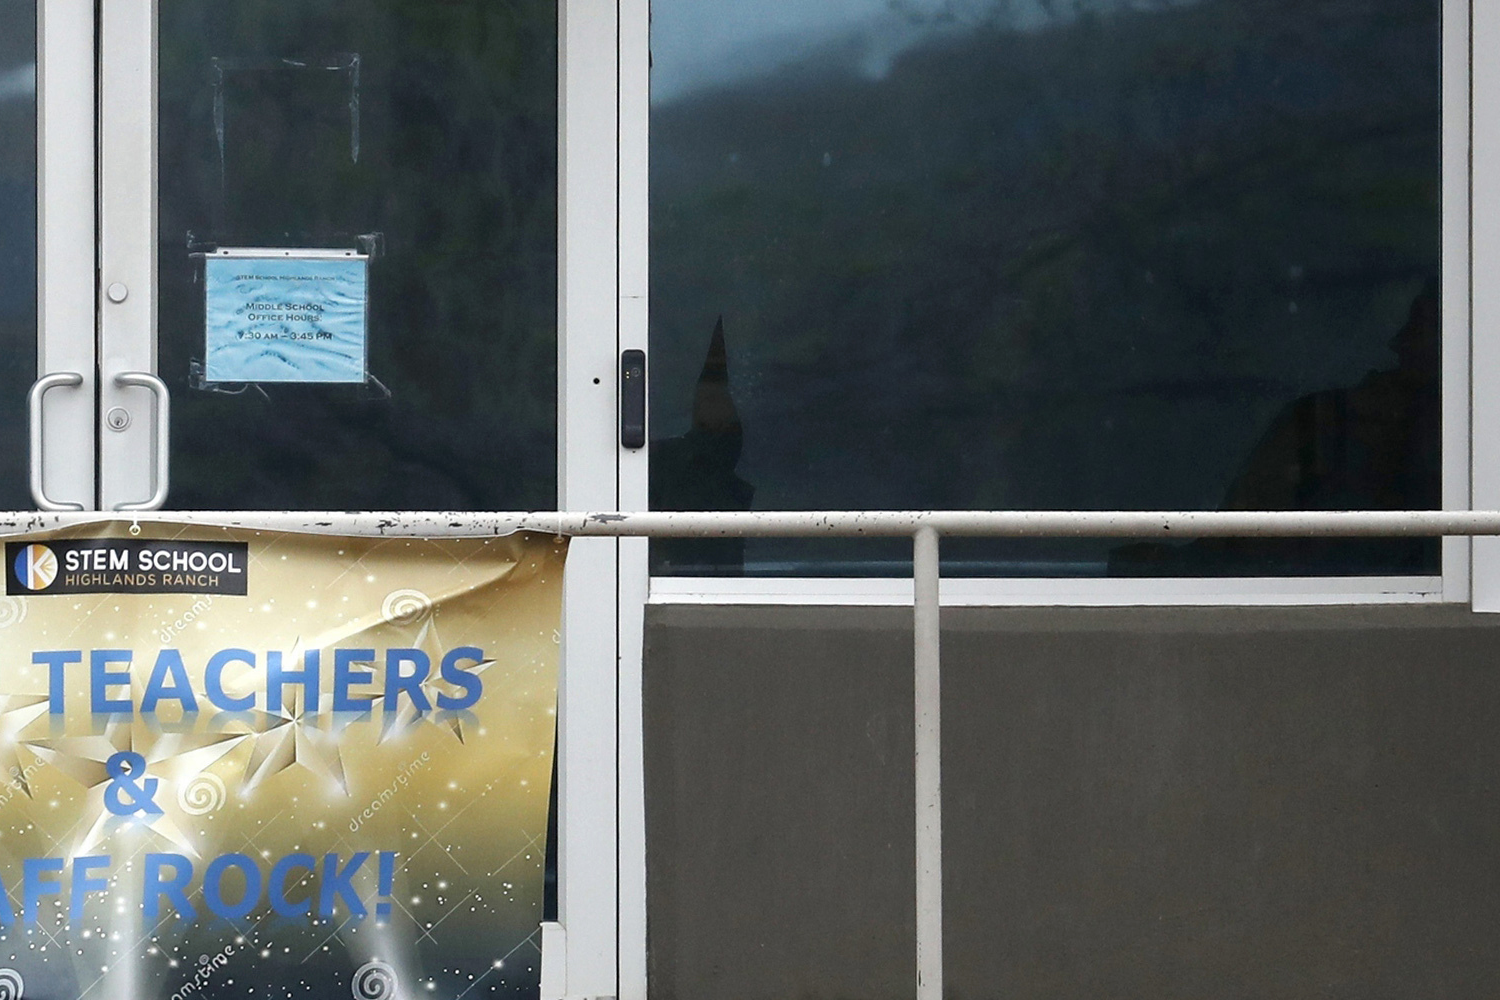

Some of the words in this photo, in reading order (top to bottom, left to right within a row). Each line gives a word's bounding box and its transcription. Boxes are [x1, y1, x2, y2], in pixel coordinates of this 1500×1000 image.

[245, 303, 283, 311] MIDDLE
[285, 303, 324, 312] SCHOOL
[248, 313, 284, 321] OFFICE
[290, 332, 313, 340] 3:45
[65, 548, 129, 572] STEM
[137, 549, 242, 577] SCHOOL
[65, 573, 157, 586] HIGHLANDS
[162, 573, 219, 587] RANCH
[33, 647, 484, 714] TEACHERS
[104, 751, 163, 816] &
[349, 751, 431, 833] dreamstime
[143, 852, 395, 921] ROCK!
